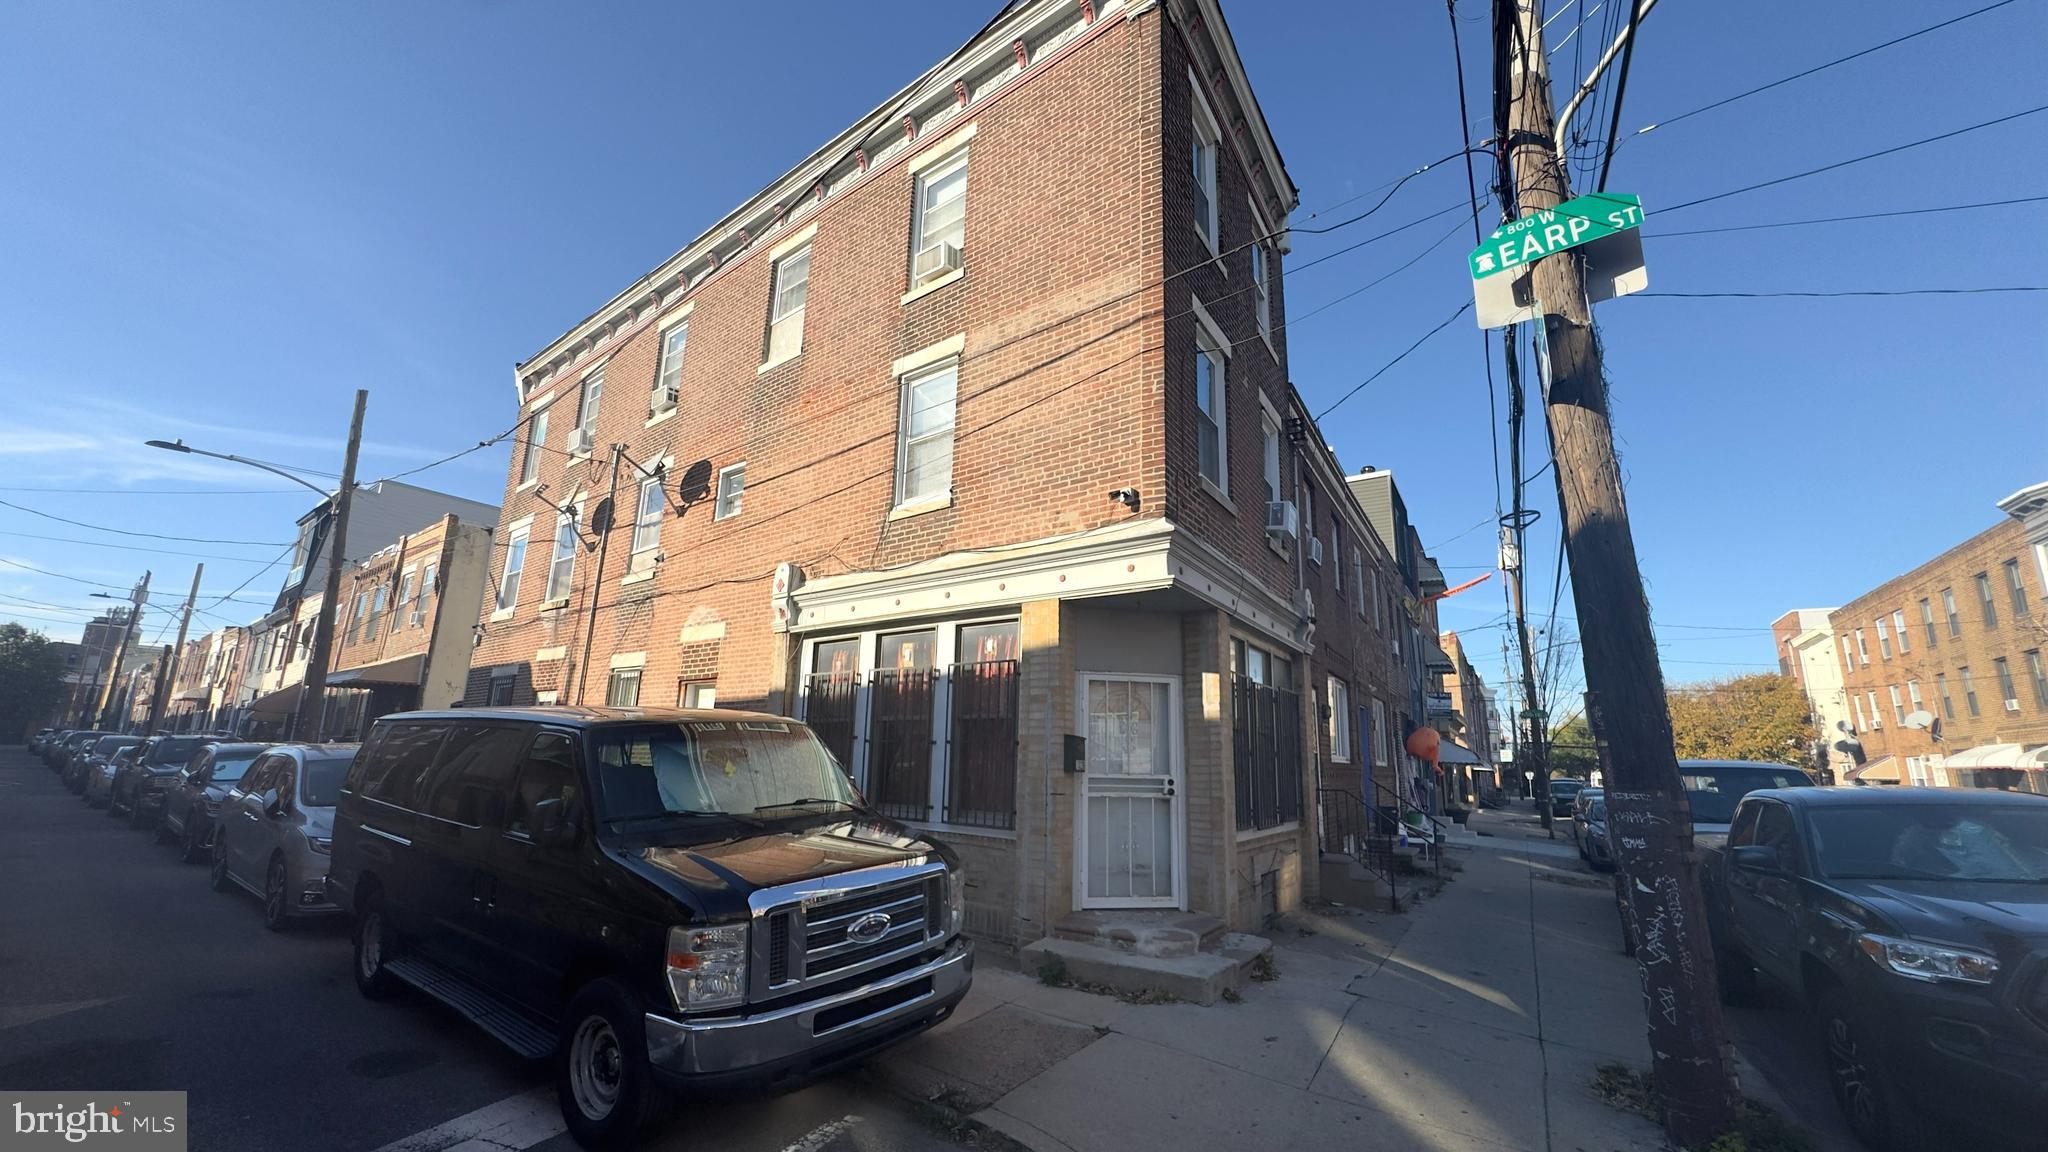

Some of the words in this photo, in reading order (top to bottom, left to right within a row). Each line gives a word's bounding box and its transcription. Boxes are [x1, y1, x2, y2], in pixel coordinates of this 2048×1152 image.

[1498, 216, 1590, 268] EARP
[1608, 206, 1636, 229] ST
[1507, 218, 1535, 235] 800
[1538, 208, 1555, 225] W
